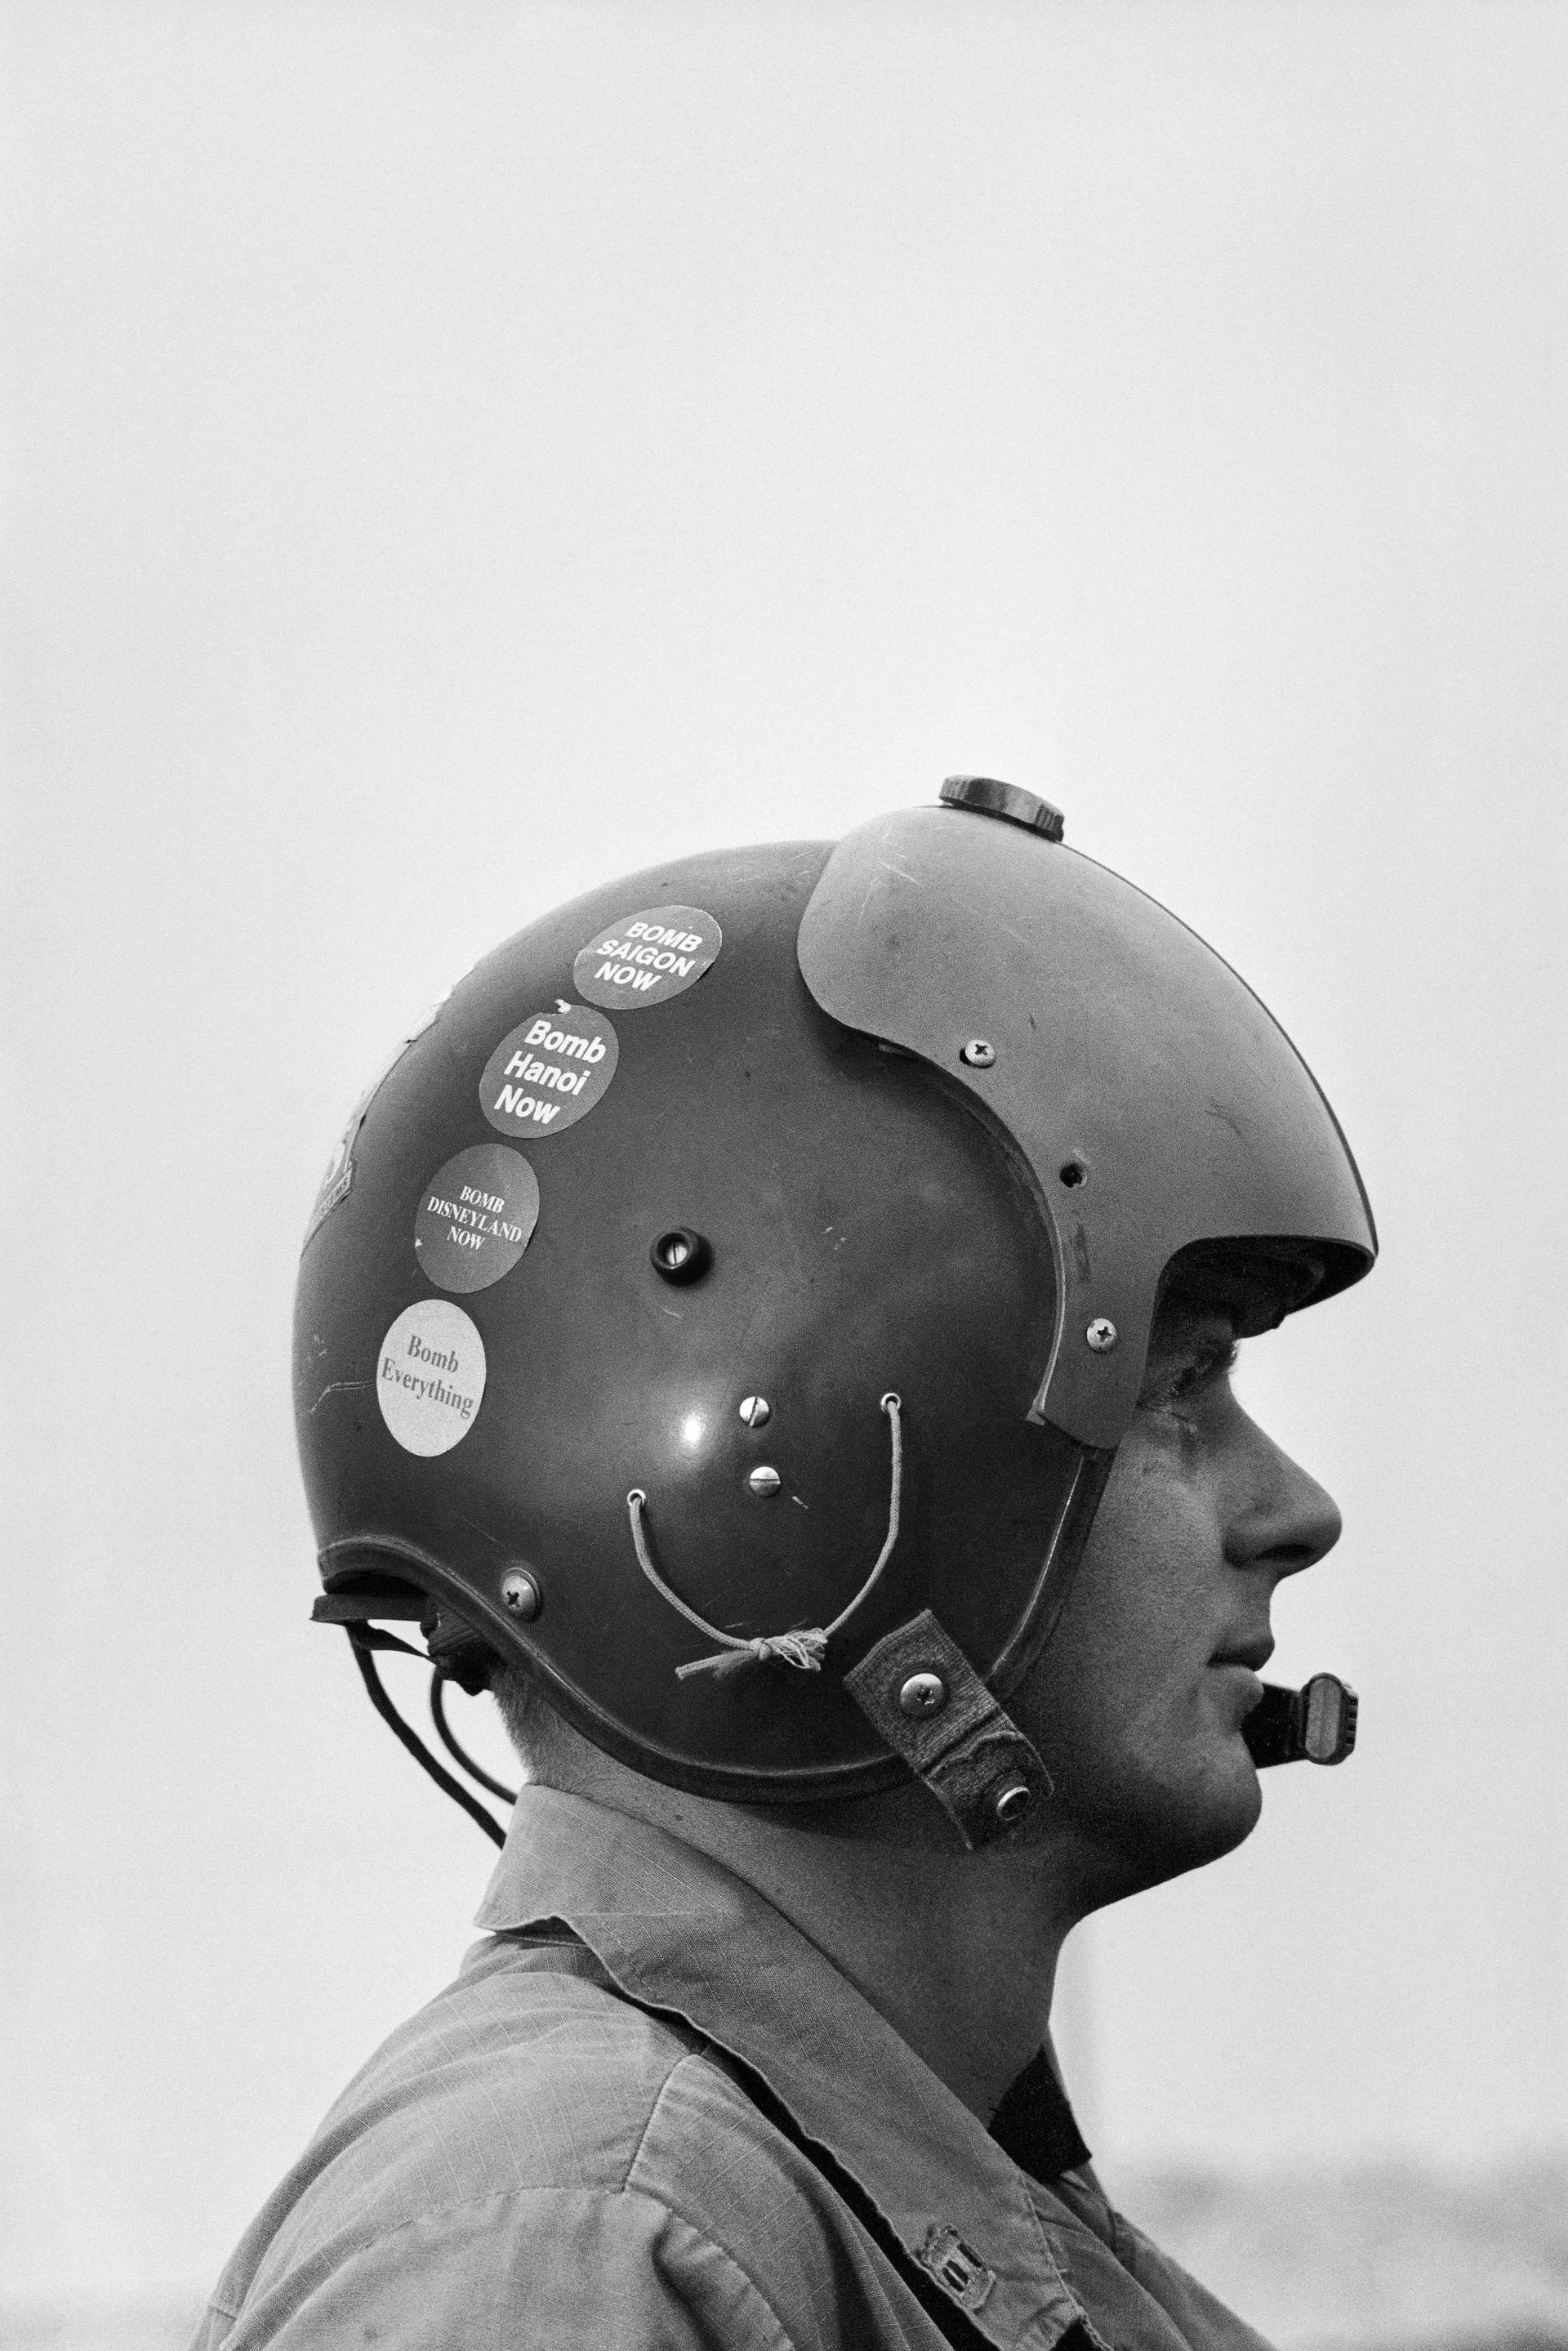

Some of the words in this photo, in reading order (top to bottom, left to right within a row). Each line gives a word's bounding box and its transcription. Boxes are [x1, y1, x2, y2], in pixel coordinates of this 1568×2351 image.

[626, 922, 703, 952] BOMB
[595, 961, 662, 991] NOW
[596, 939, 696, 977] SAIGON
[524, 1020, 606, 1064] Bomb
[504, 1051, 591, 1095] Hanoi
[494, 1084, 561, 1124] Now
[459, 1185, 505, 1213] BOMB
[427, 1196, 523, 1242] DISNEYLAND
[447, 1225, 486, 1251] NOW
[407, 1335, 459, 1373] Bomb
[382, 1358, 474, 1419] Everything
